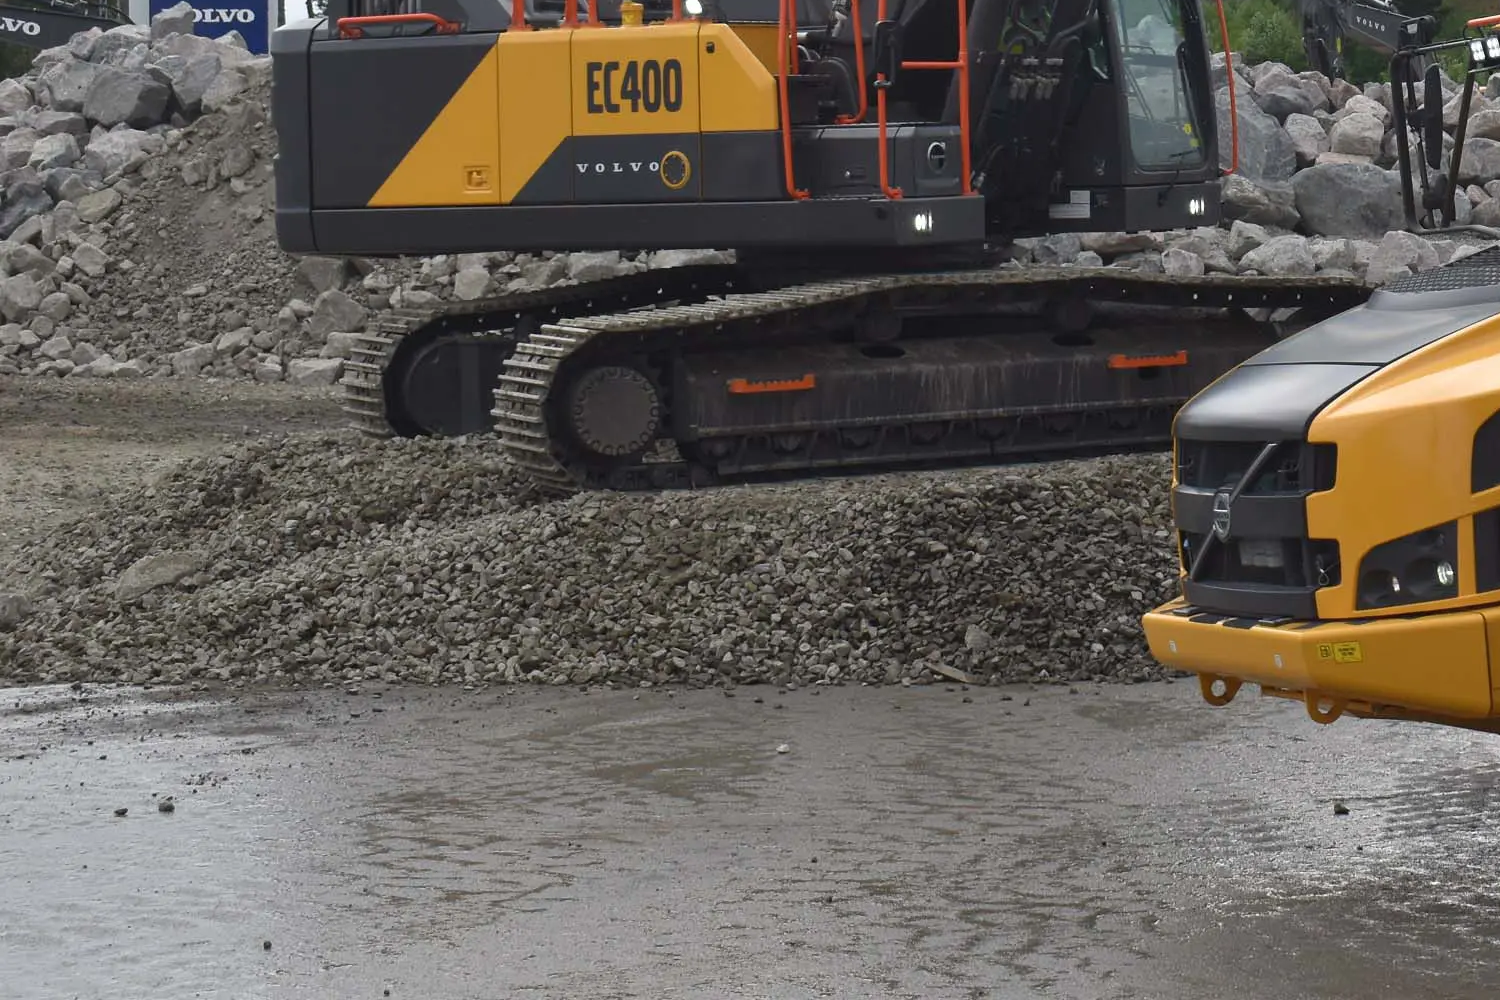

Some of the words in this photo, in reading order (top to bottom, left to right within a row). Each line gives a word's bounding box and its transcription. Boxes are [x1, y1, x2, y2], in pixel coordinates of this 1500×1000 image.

[162, 8, 255, 23] OLVO
[1356, 16, 1386, 32] VOLVO
[586, 58, 683, 114] EC400
[576, 161, 660, 174] VOLVO
